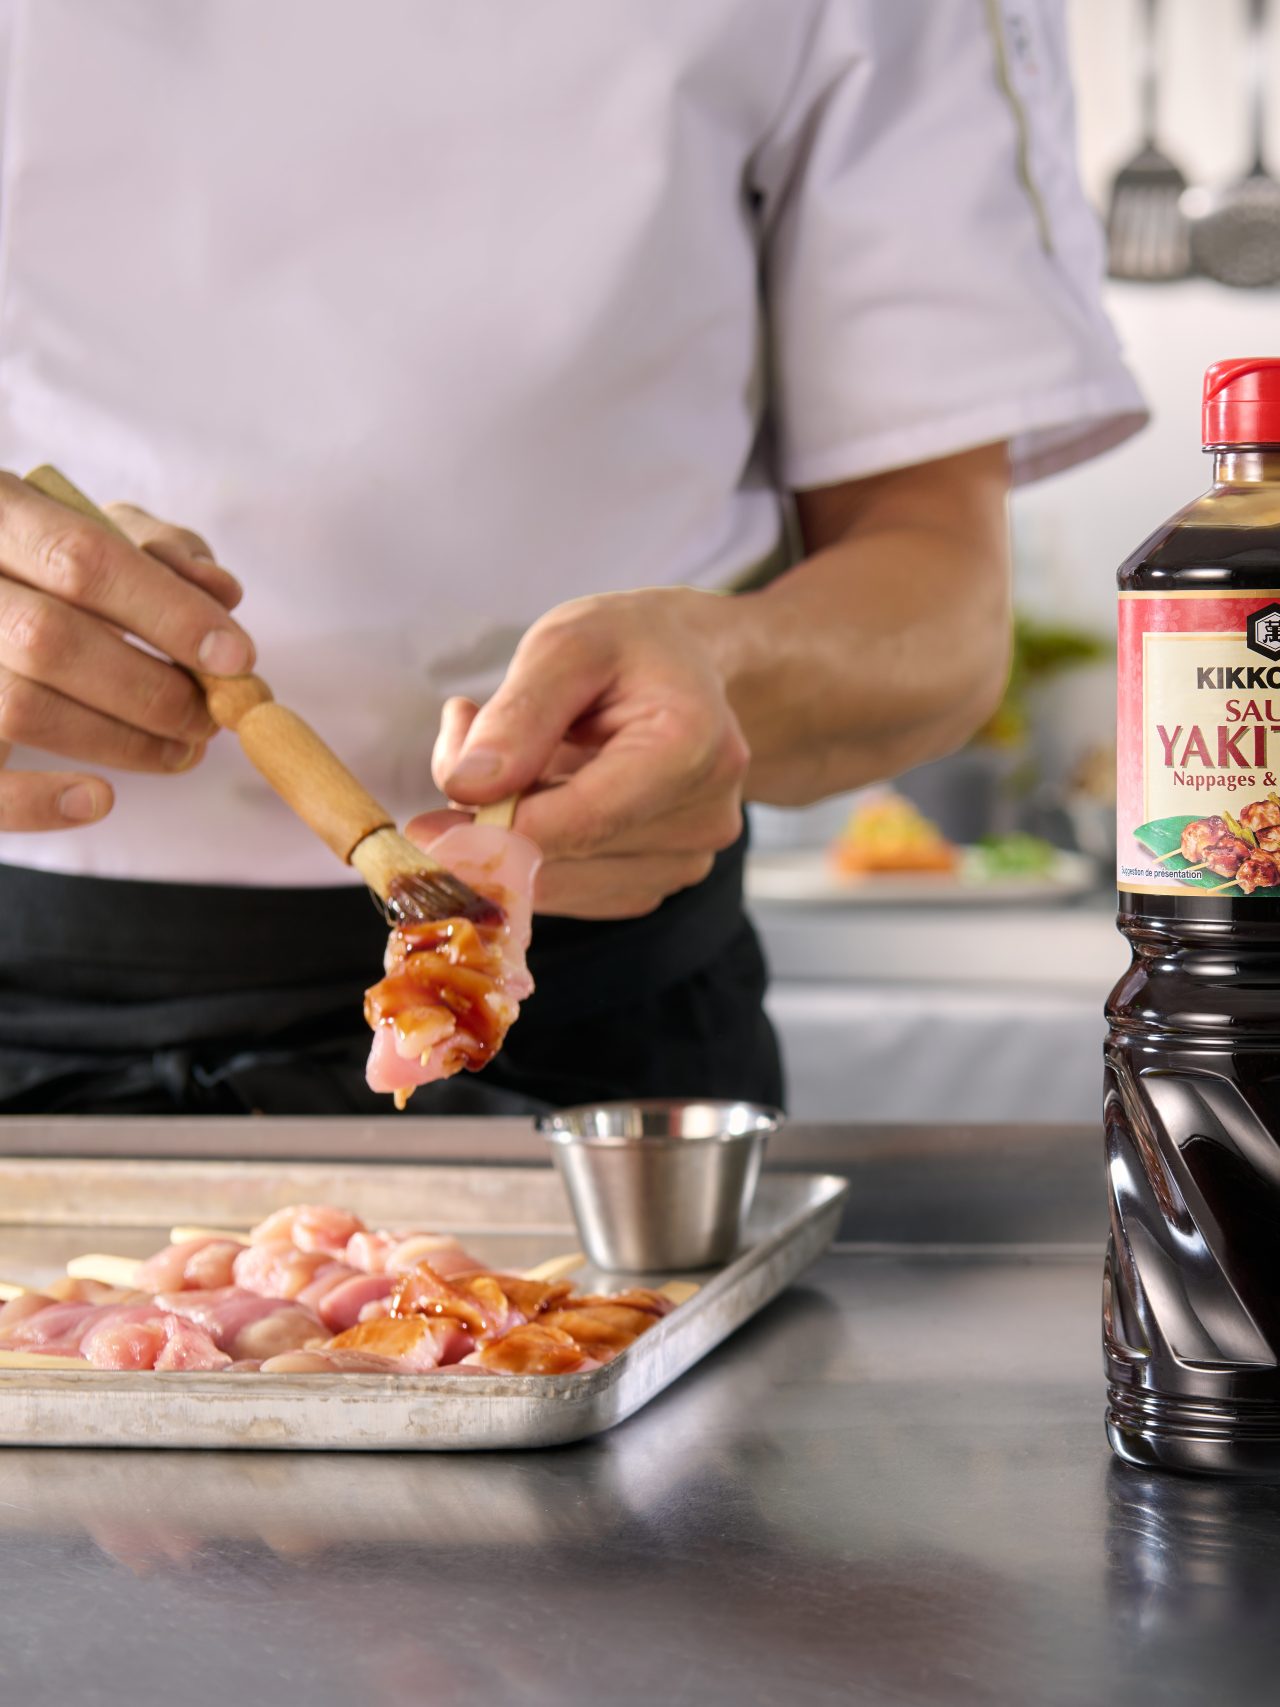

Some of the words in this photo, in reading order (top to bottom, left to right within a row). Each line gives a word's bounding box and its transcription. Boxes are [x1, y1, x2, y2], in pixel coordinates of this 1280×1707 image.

[1173, 771, 1256, 792] Nappages
[1263, 772, 1277, 787] &
[1145, 868, 1153, 877] de
[1153, 868, 1202, 879] présentation
